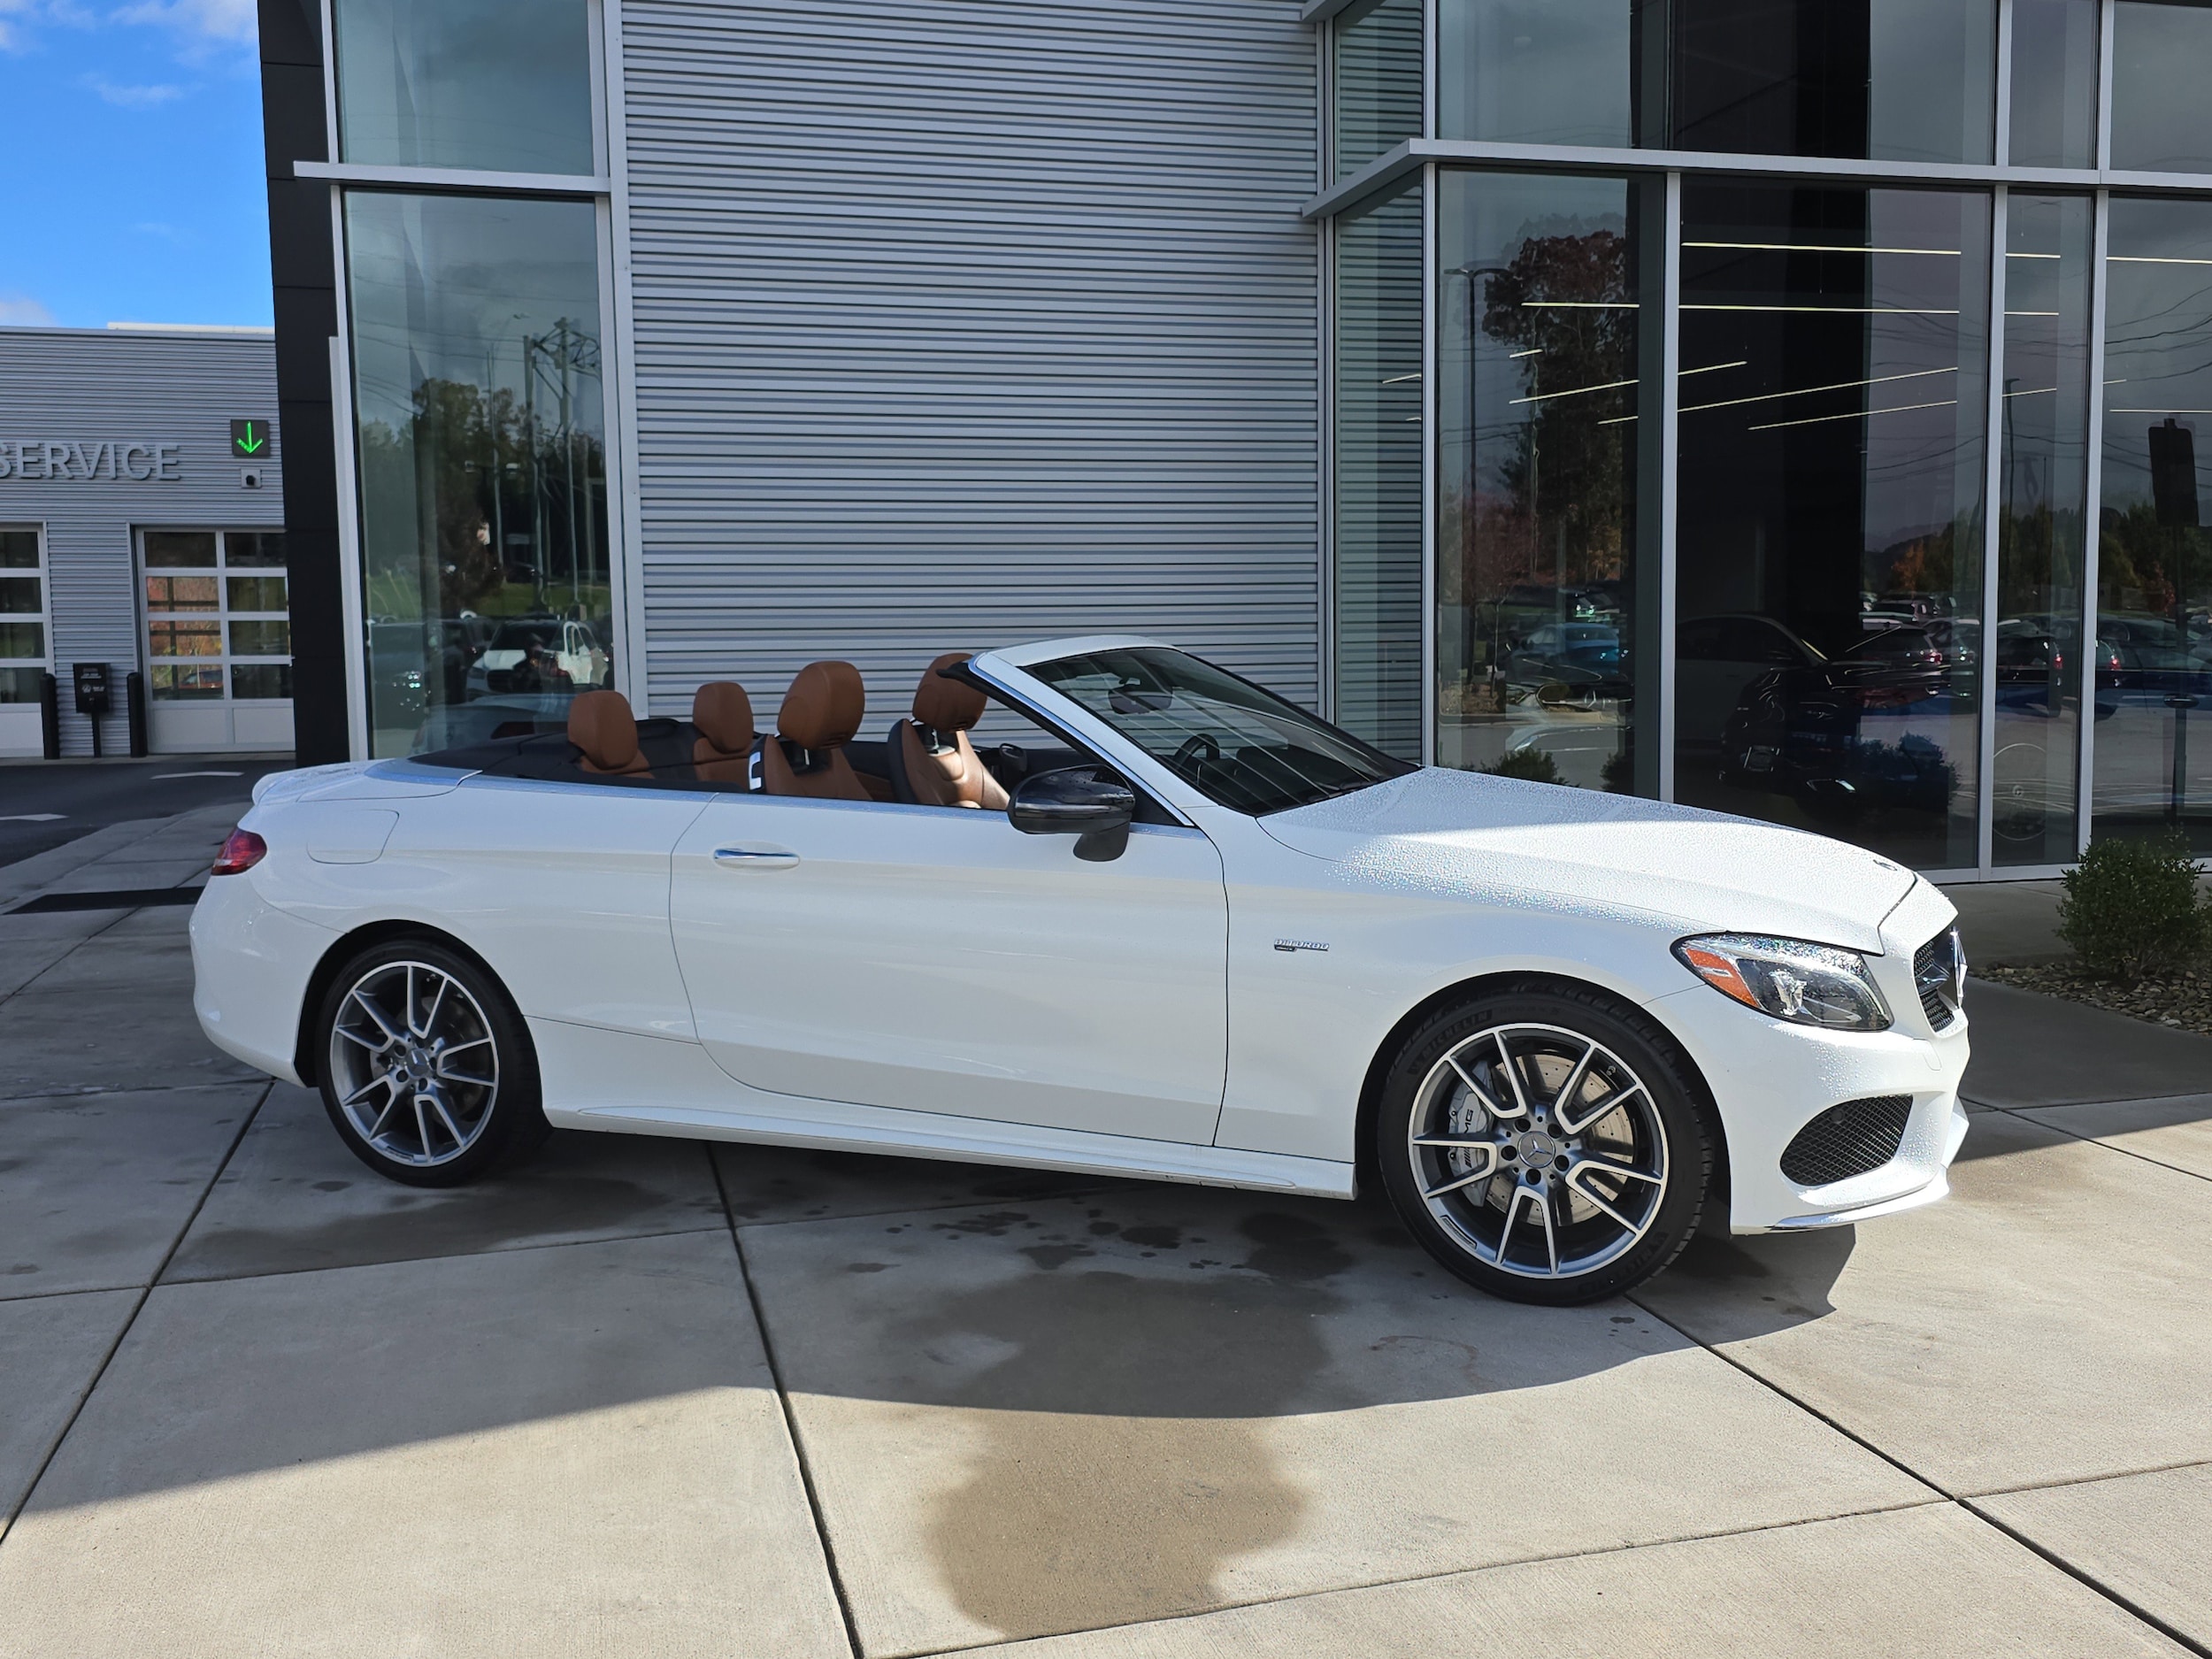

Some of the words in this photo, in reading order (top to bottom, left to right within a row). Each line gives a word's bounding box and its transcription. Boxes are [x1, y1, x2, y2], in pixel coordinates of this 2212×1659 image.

[1274, 939, 1330, 950] BITURBO
[1422, 1011, 1489, 1056] MICHELIN
[1463, 1109, 1476, 1134] MG
